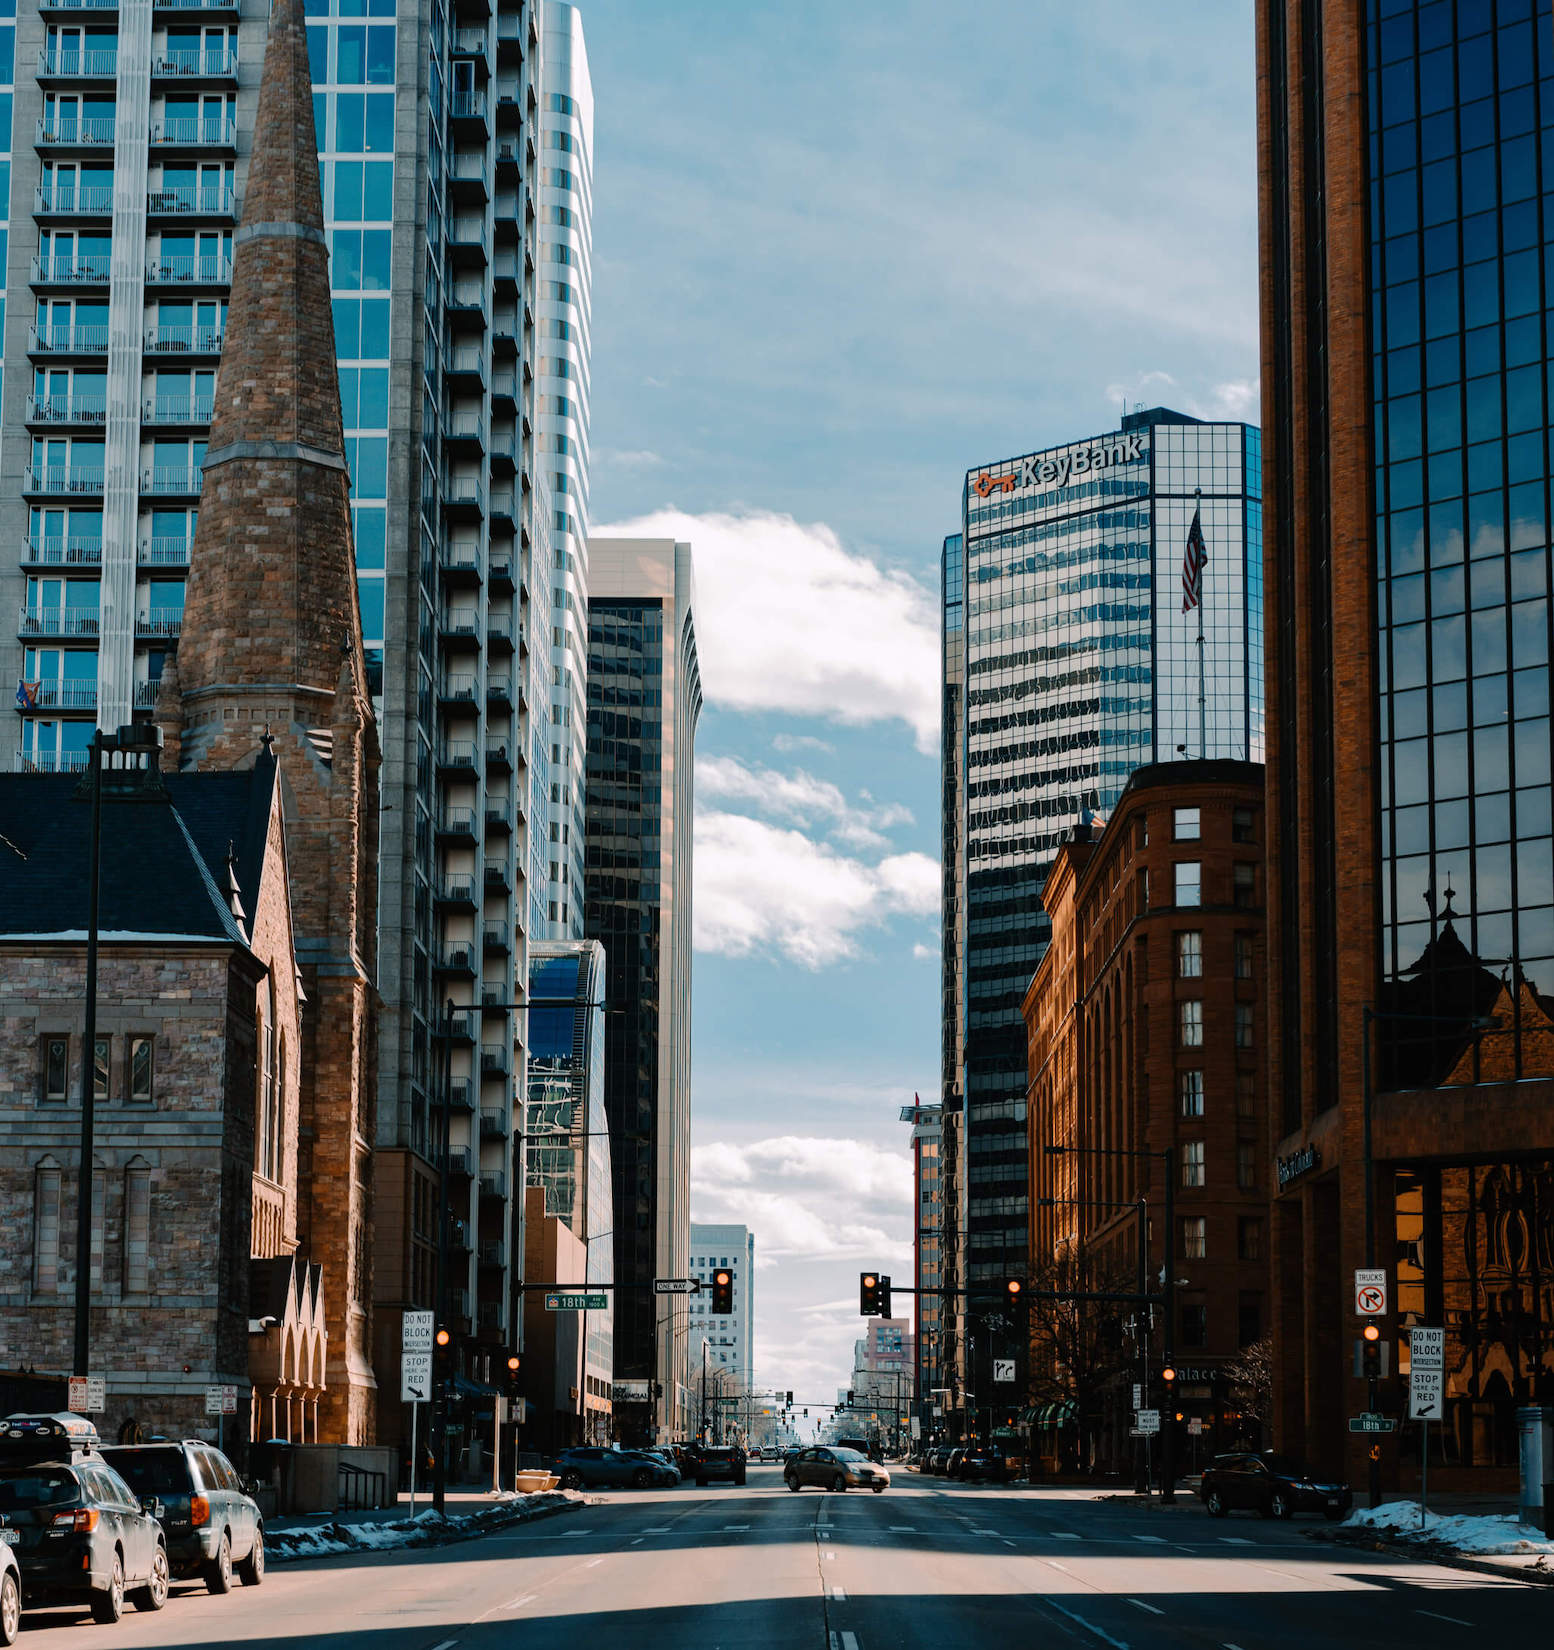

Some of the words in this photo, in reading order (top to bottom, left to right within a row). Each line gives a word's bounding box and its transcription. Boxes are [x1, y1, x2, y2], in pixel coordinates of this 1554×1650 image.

[1021, 435, 1142, 488] KeyBank
[1358, 1273, 1384, 1281] TRUCKS
[562, 1296, 586, 1308] 18th
[405, 1314, 415, 1324] DO
[416, 1314, 431, 1324] NOT
[404, 1328, 431, 1337] BLOCK
[1413, 1331, 1424, 1341] DO
[1426, 1331, 1441, 1341] NOT
[1413, 1345, 1441, 1355] BLOCK
[406, 1357, 428, 1366] STOP
[408, 1375, 424, 1383] RED
[1414, 1374, 1438, 1383] STOP
[1416, 1393, 1435, 1401] RED
[1363, 1420, 1380, 1430] 18th
